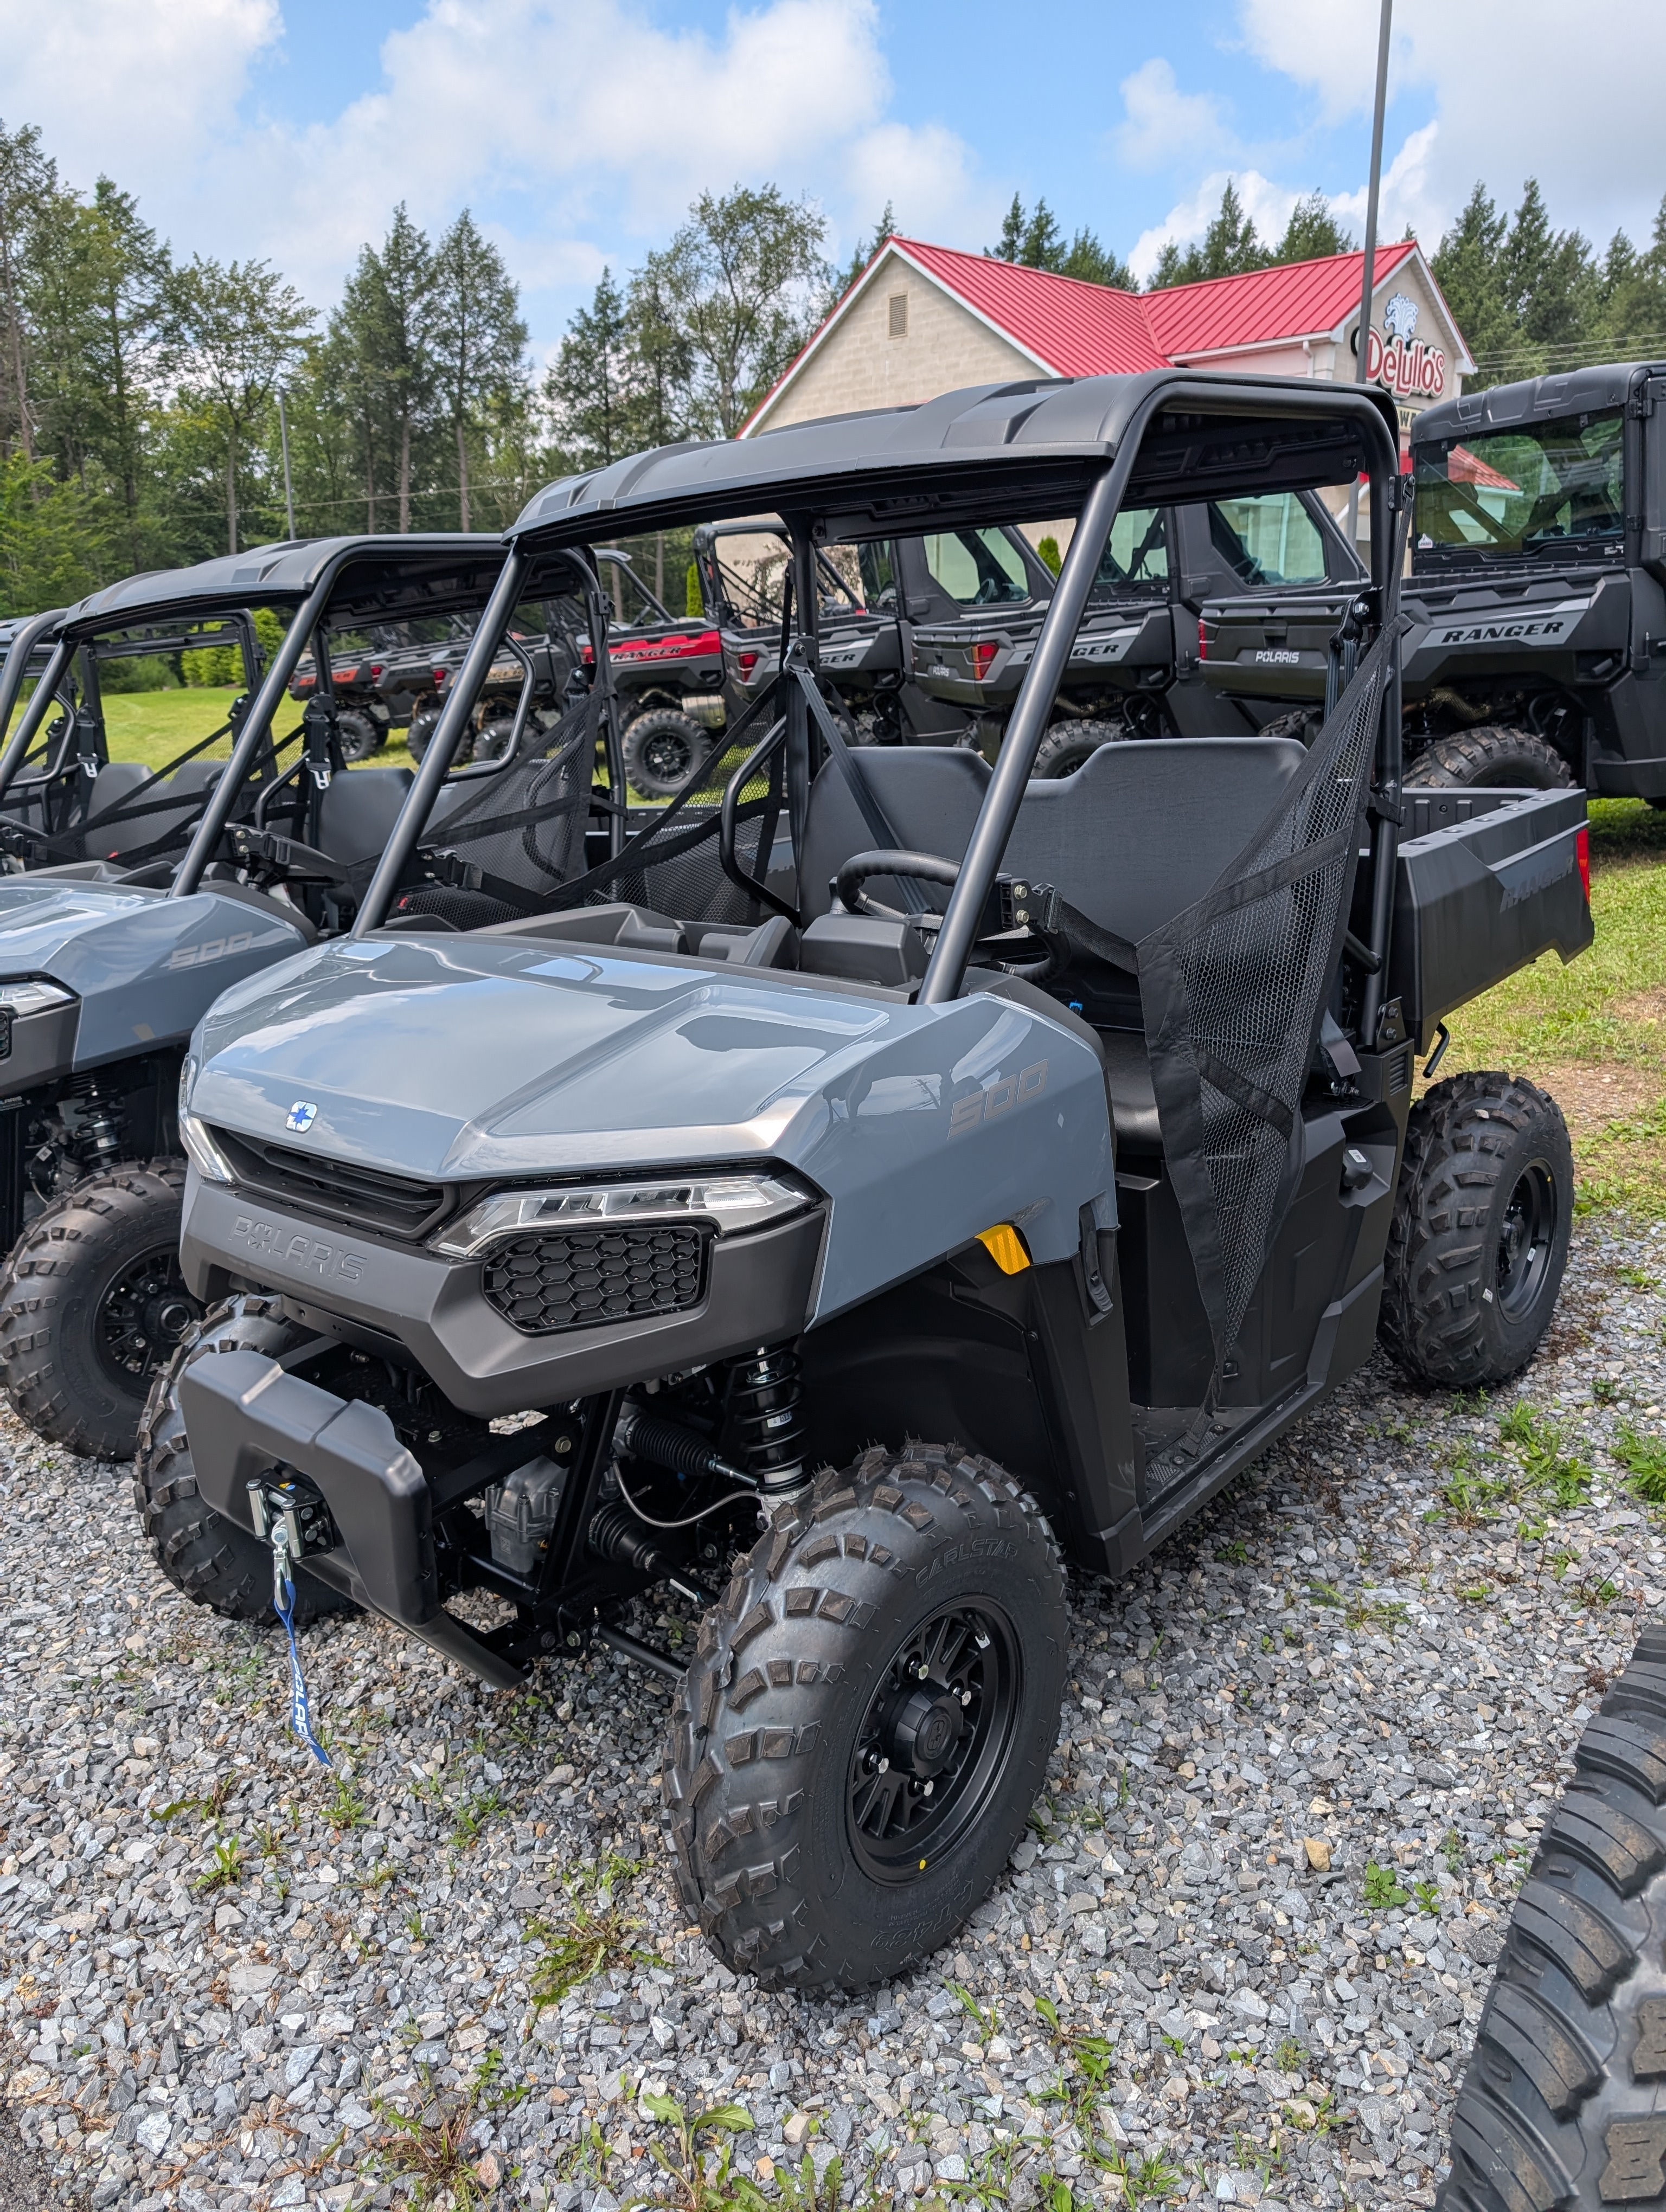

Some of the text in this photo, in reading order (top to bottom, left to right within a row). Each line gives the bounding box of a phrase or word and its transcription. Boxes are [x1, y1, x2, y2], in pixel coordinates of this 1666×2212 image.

[1441, 621, 1564, 644] RANGER
[613, 647, 682, 660] RANGER
[819, 654, 856, 664] GER
[1255, 651, 1300, 664] POLARIS
[168, 930, 253, 971] 500
[947, 1058, 1049, 1140] 500
[228, 1214, 368, 1287] POLARIS
[915, 1539, 1018, 1590] CARLSTAR
[292, 1656, 318, 1747] POLARIS
